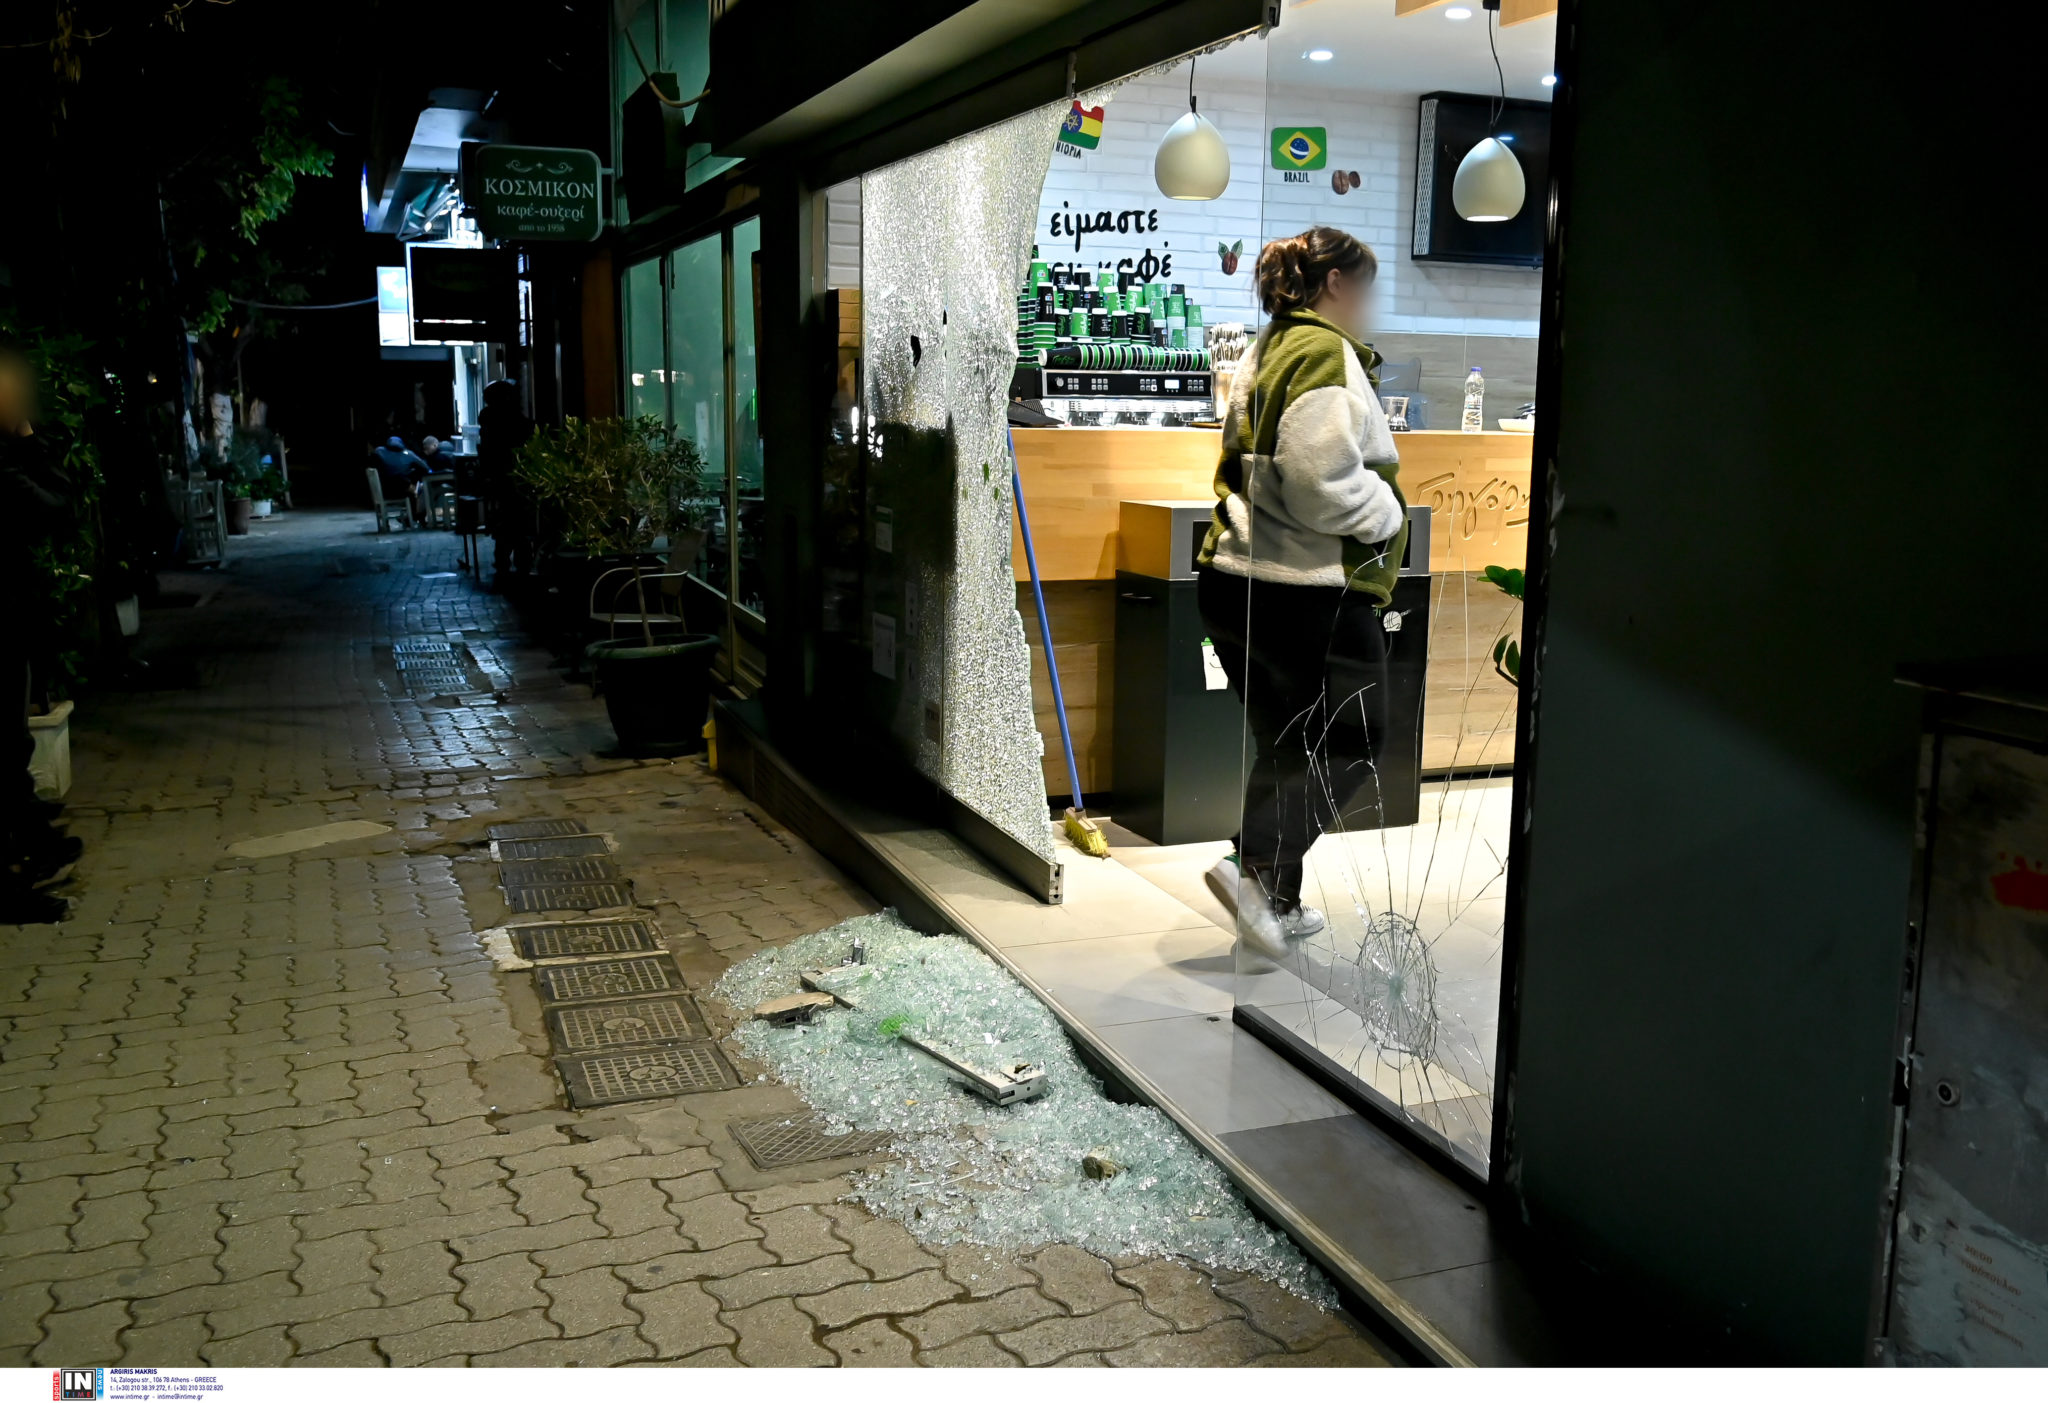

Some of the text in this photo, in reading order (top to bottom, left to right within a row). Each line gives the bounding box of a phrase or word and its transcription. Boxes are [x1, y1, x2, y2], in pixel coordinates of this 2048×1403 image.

[1284, 171, 1311, 183] BRAZIL
[484, 178, 595, 199] ΚΟΣΜΙΚΟΝ
[497, 203, 585, 222] καφέ-ουζερί
